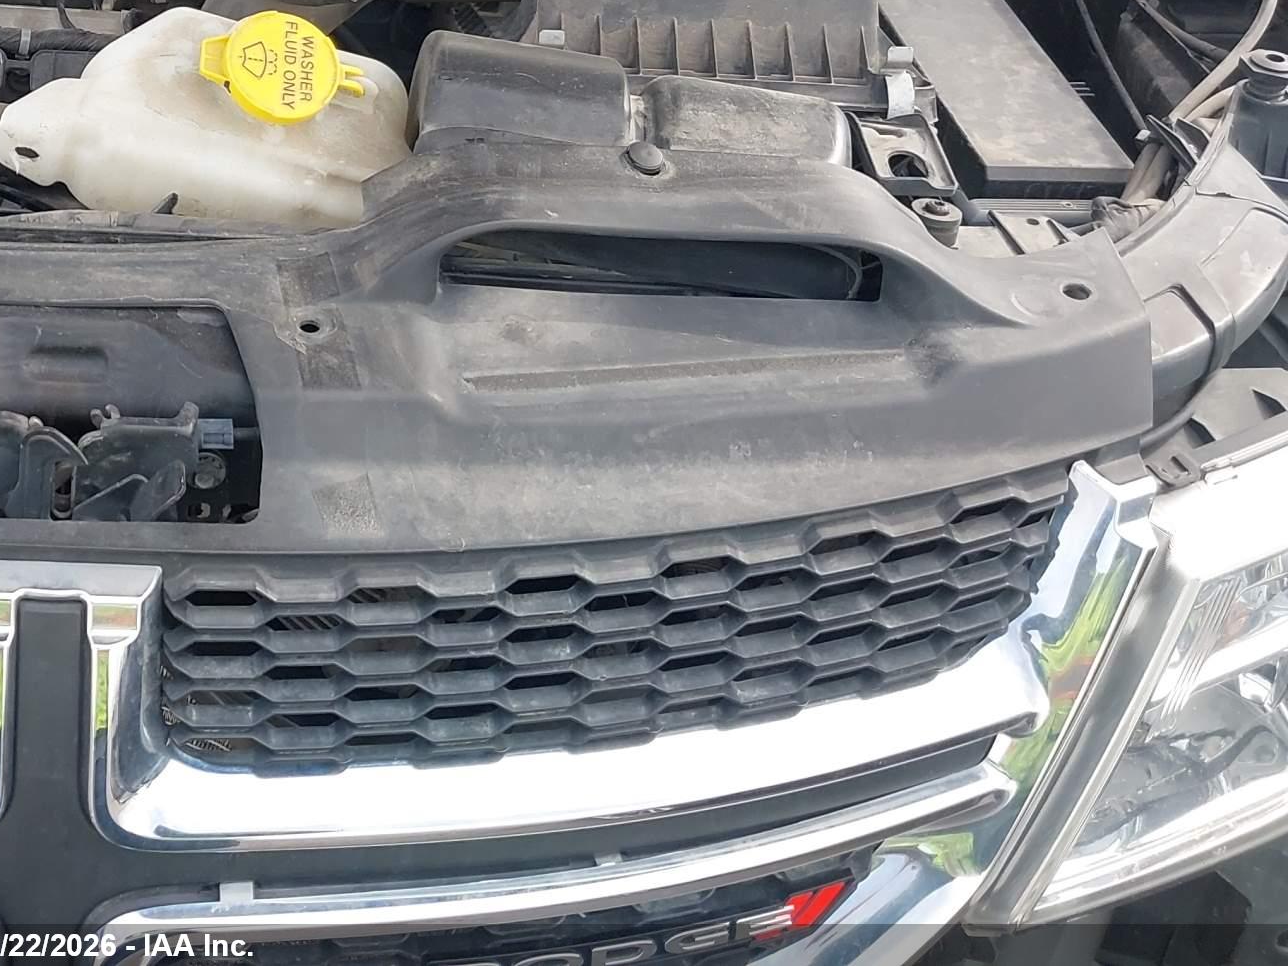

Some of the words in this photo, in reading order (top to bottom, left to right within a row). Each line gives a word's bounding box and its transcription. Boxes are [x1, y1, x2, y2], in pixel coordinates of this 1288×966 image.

[284, 20, 298, 65] FLUID
[299, 35, 315, 102] WASHER
[281, 69, 297, 110] ONLY
[436, 905, 794, 966] DGE
